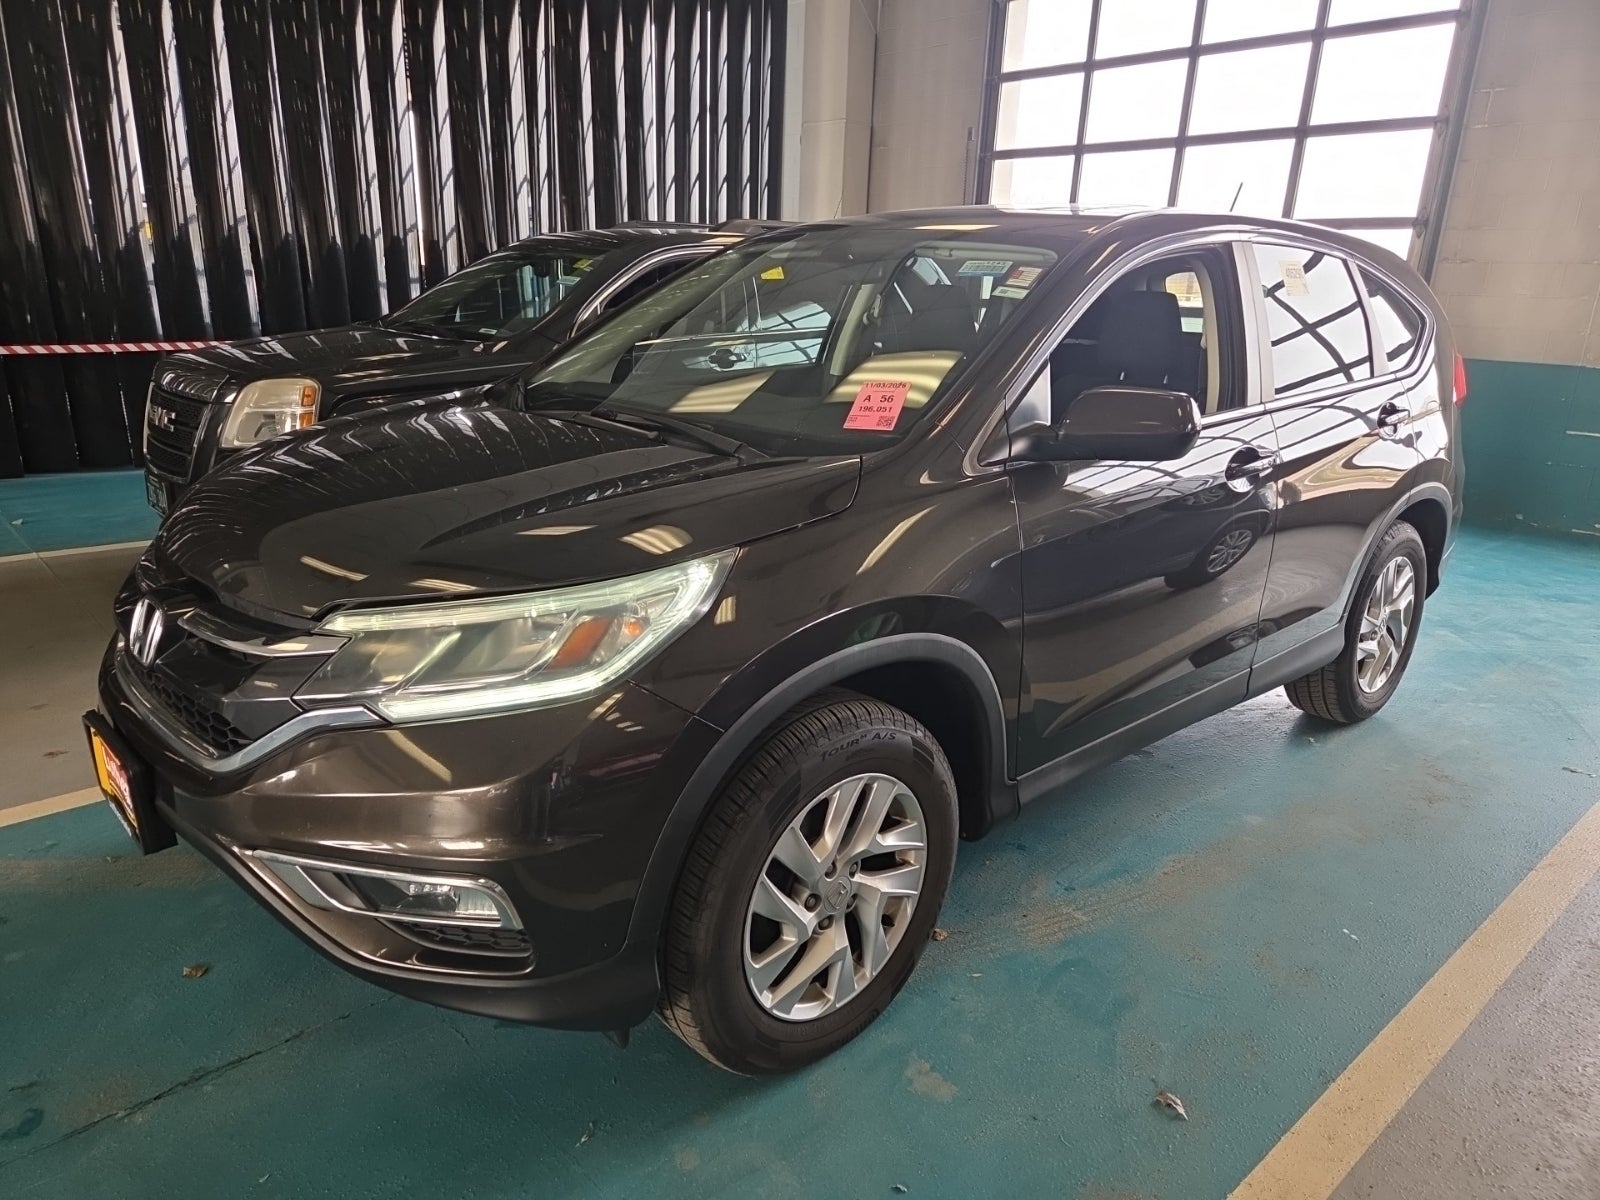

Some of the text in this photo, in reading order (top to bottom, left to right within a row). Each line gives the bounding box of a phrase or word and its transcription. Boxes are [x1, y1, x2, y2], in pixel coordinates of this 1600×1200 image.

[863, 394, 895, 403] A 56
[872, 732, 897, 741] A/S
